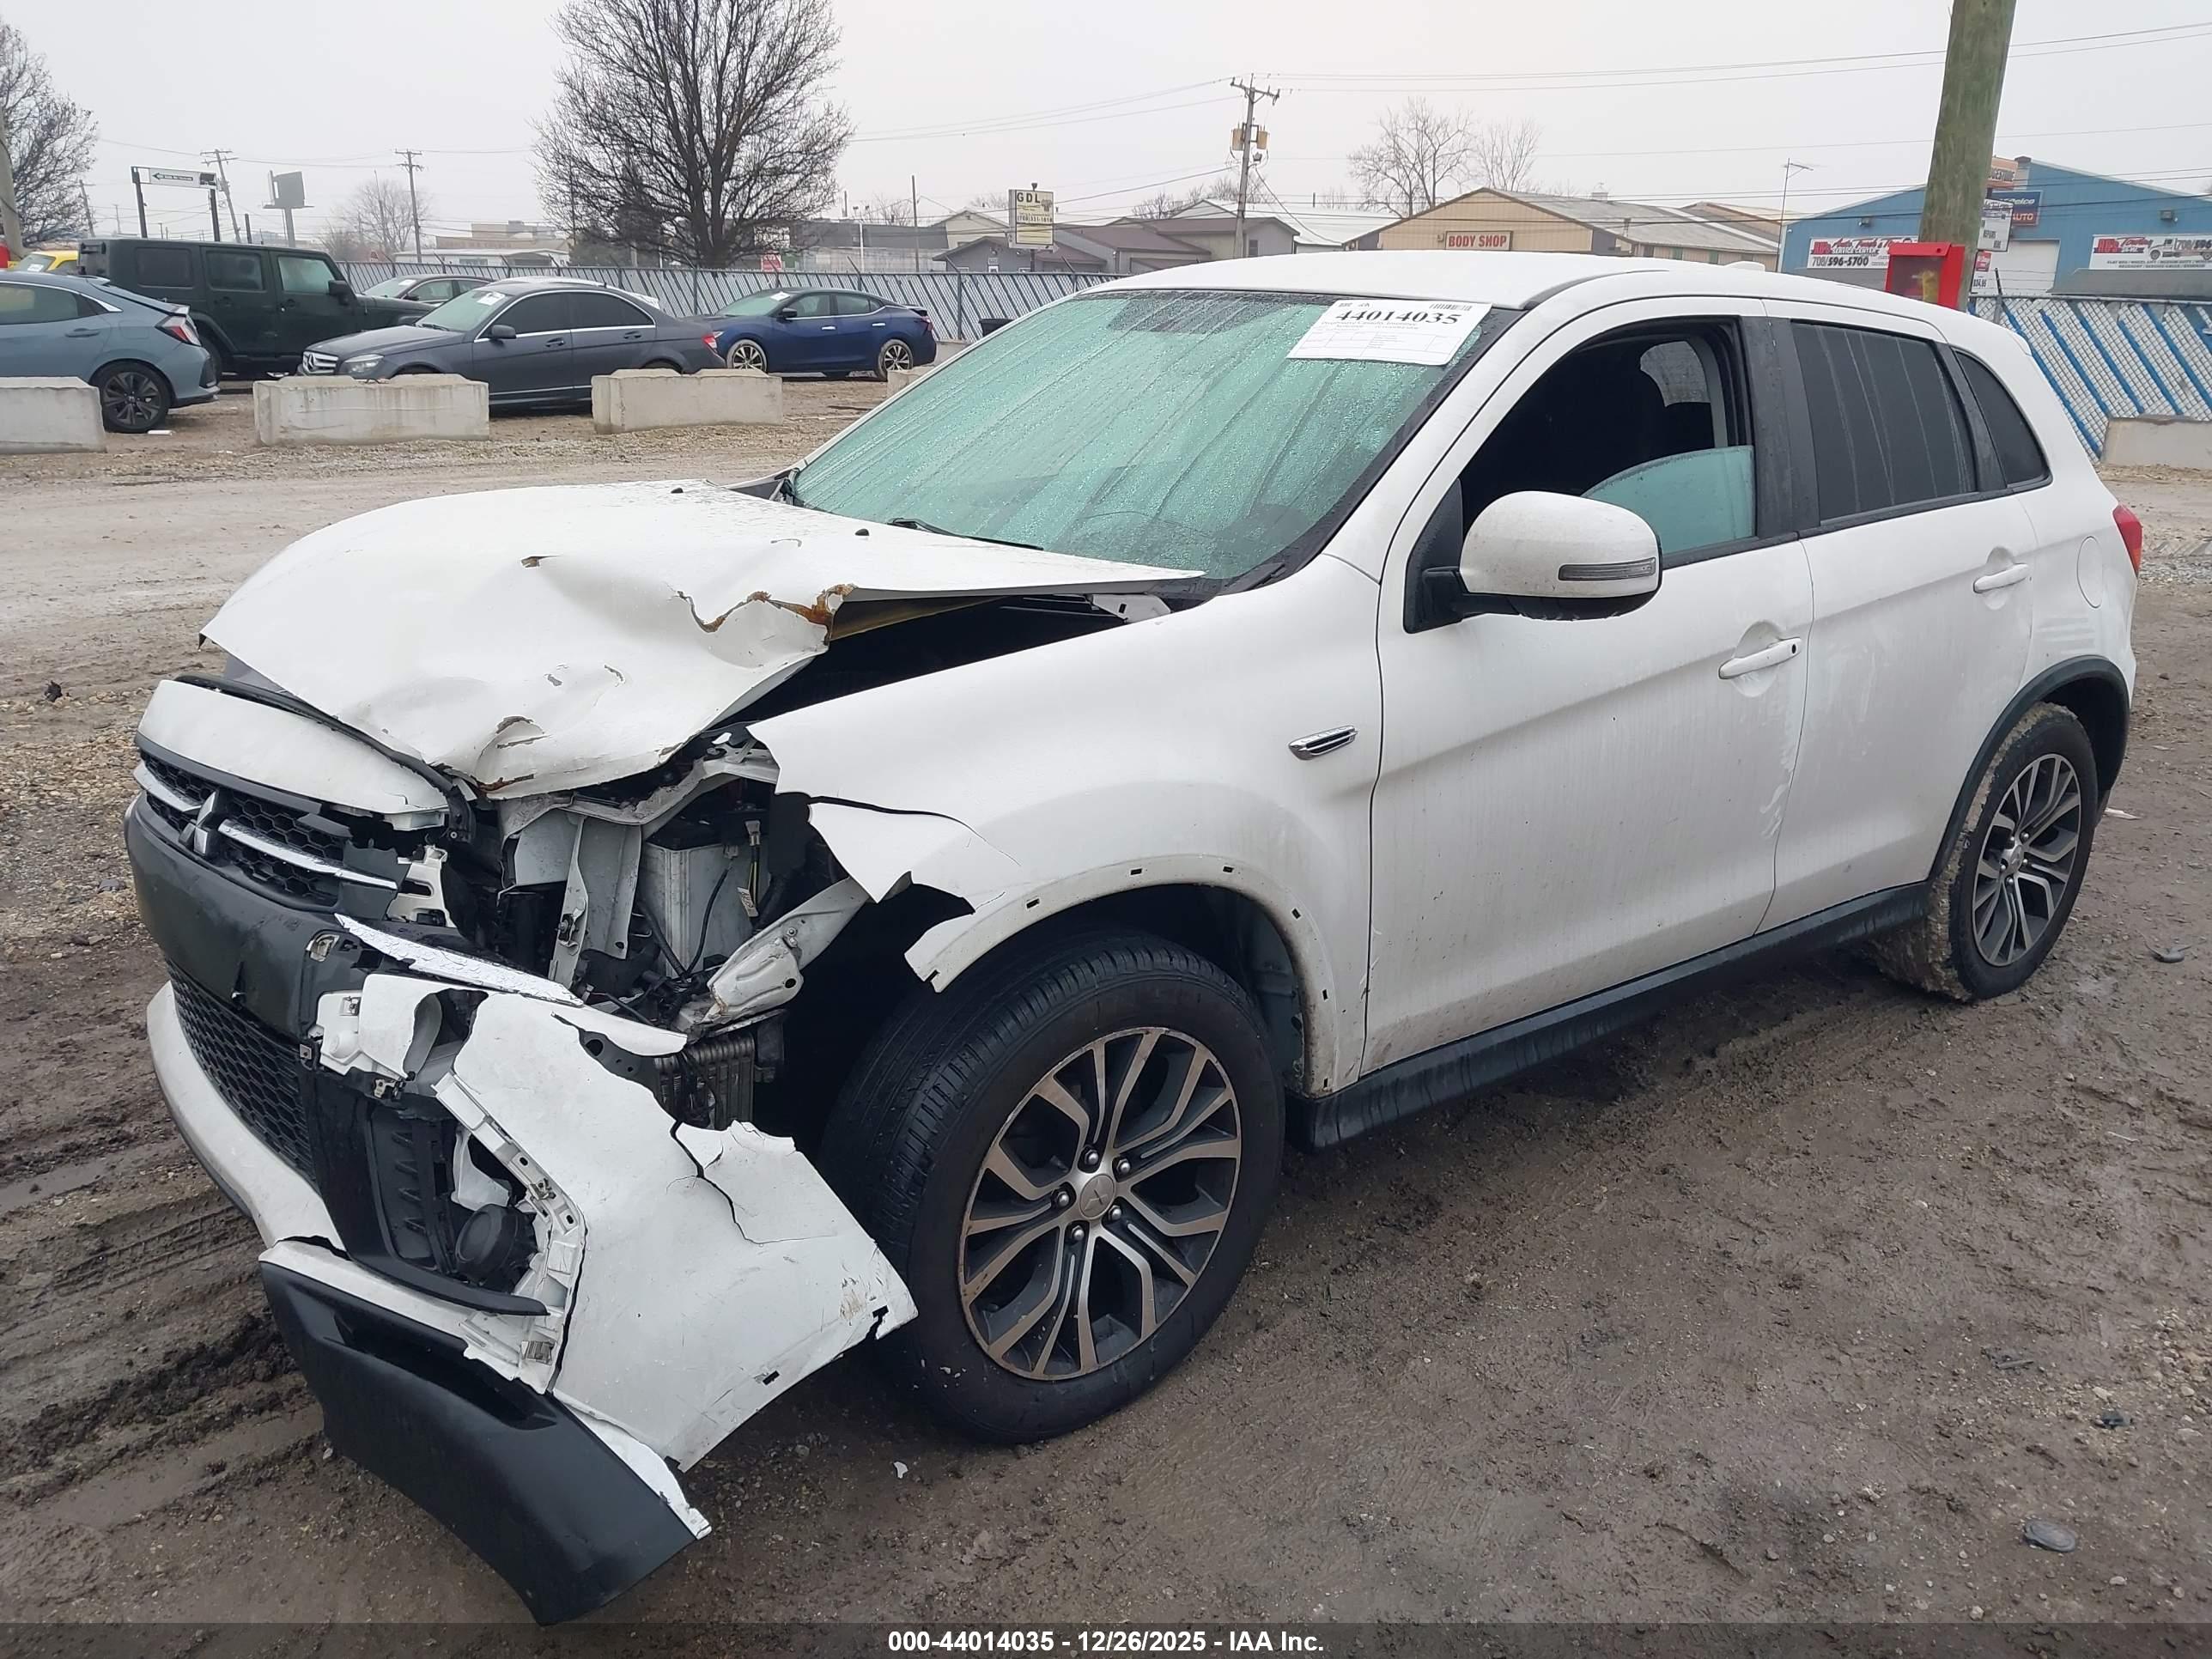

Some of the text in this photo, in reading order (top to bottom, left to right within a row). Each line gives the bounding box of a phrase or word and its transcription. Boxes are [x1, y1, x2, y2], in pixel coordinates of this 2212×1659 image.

[1017, 191, 1040, 204] GDL
[1449, 235, 1507, 247] BODY SHOP
[1811, 256, 1869, 267] 708/596-5700
[1335, 310, 1462, 325] 44014035
